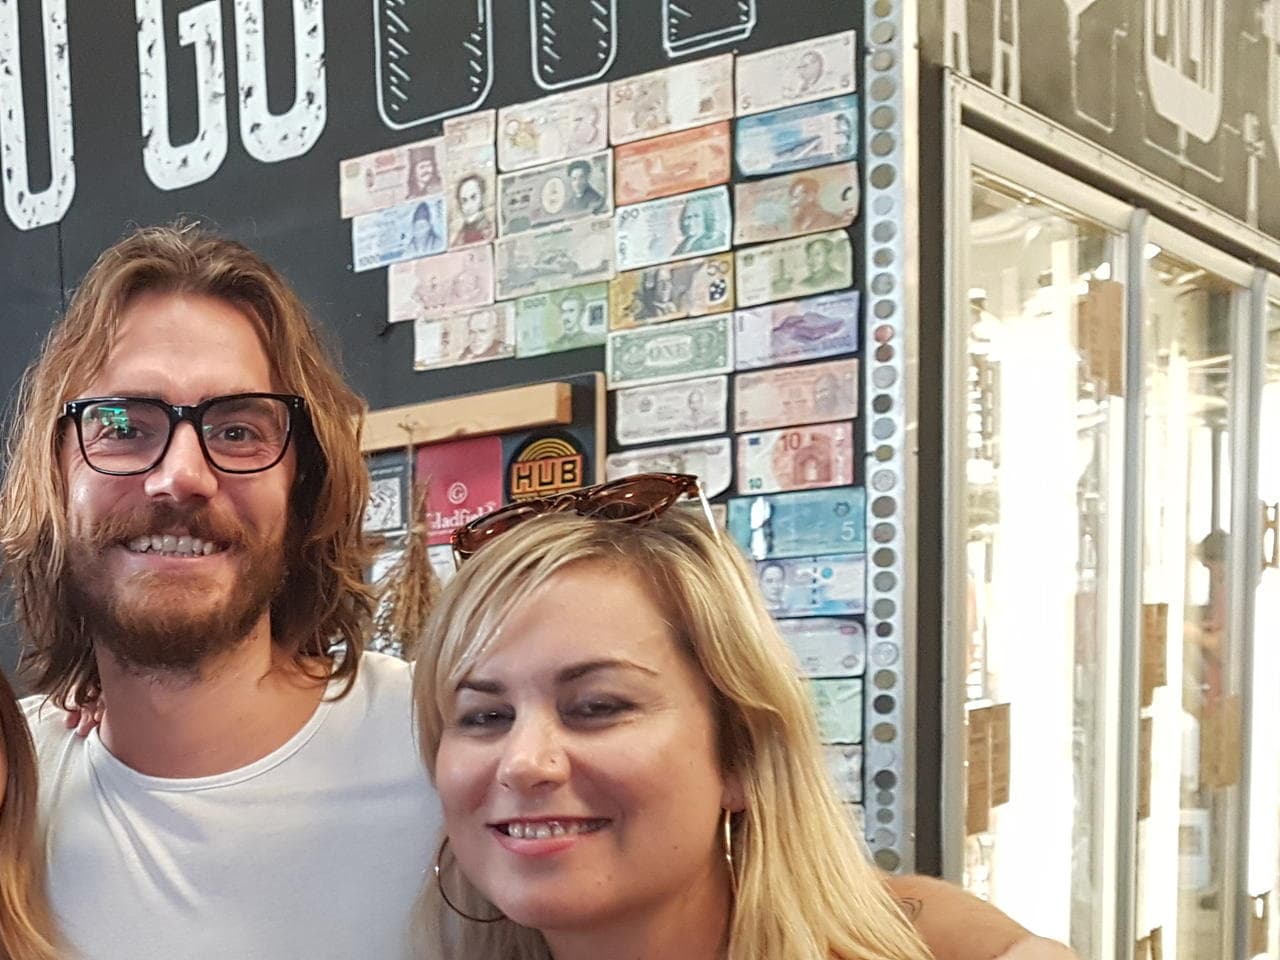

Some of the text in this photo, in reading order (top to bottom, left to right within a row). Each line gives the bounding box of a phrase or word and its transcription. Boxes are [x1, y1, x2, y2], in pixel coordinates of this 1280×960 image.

[134, 0, 327, 191] GO
[782, 432, 801, 452] 10
[515, 458, 579, 492] HUB
[840, 520, 856, 542] 5
